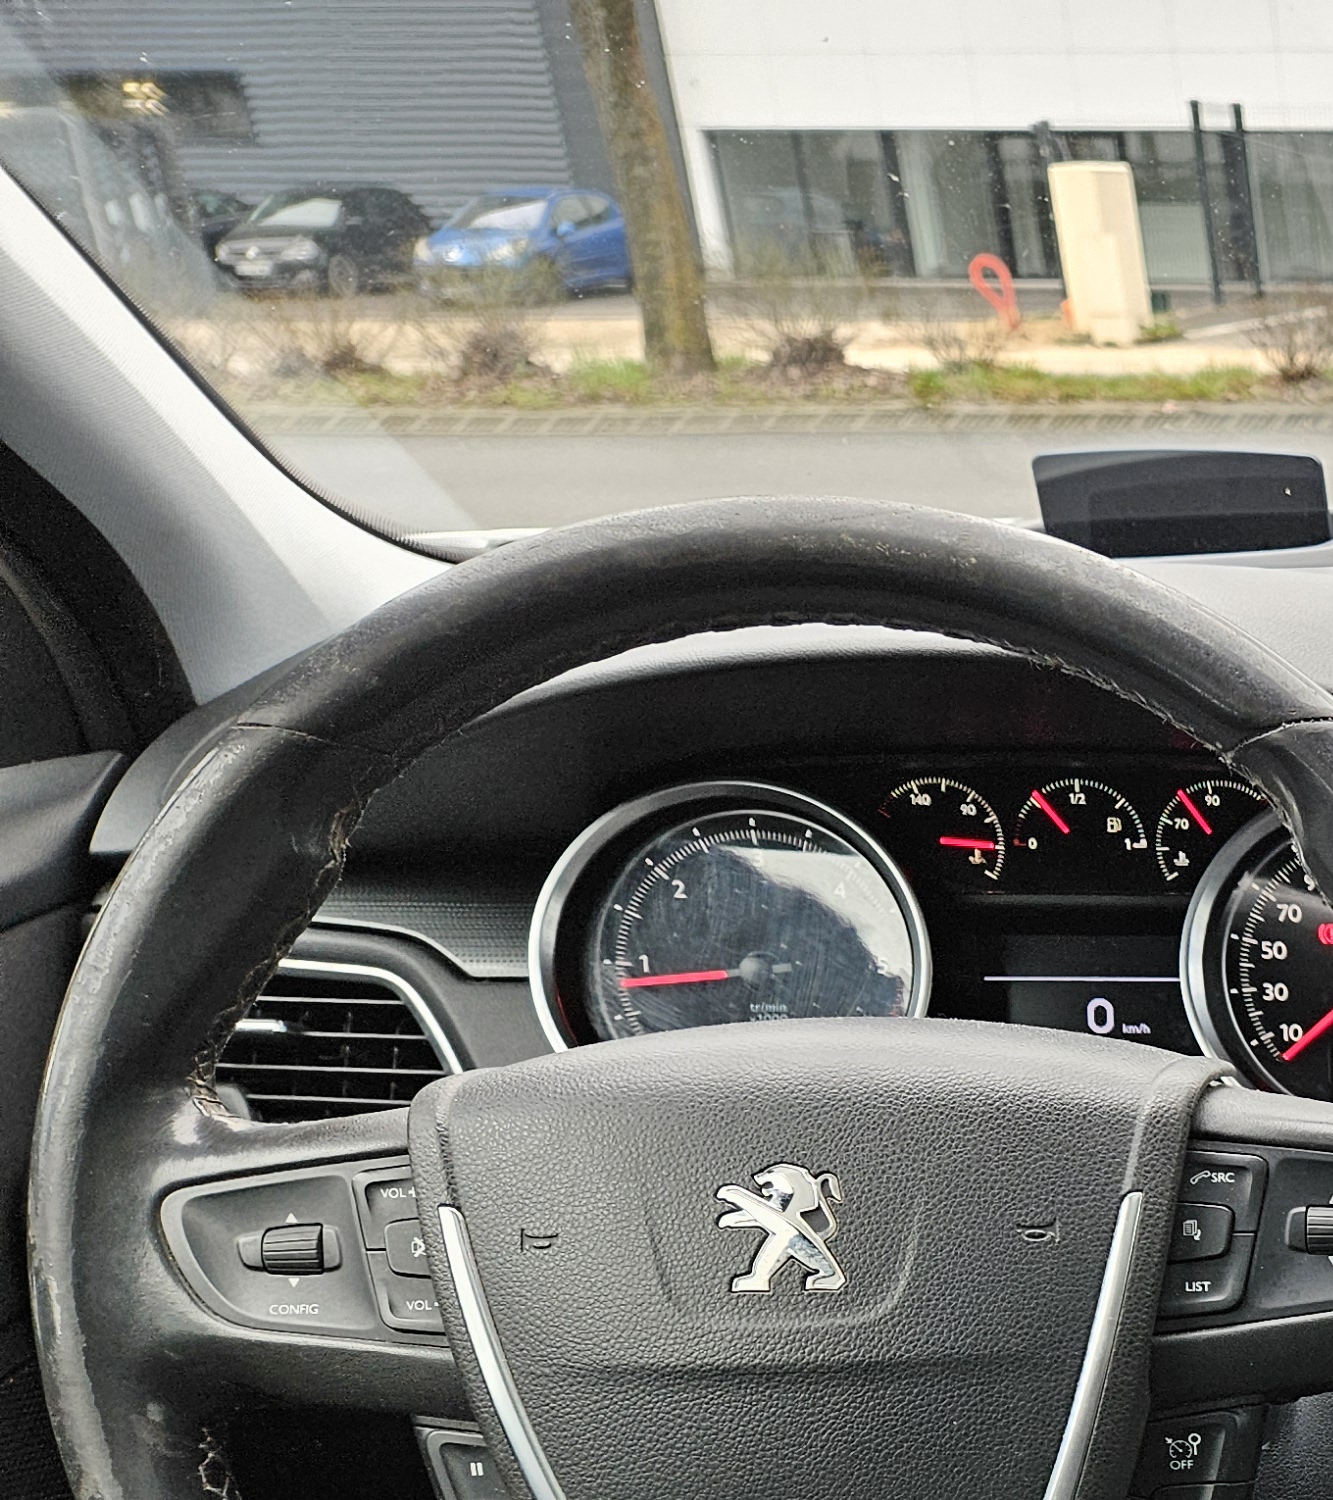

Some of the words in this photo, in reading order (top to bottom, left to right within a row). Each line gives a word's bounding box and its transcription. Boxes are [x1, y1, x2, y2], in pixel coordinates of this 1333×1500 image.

[910, 793, 932, 806] 140
[1069, 793, 1087, 805] 1/2
[1204, 794, 1221, 807] 90
[960, 803, 977, 816] 90
[1174, 818, 1190, 830] 70
[1028, 838, 1038, 850] 0
[1124, 839, 1133, 850] 1
[671, 880, 688, 899] 2
[834, 881, 846, 898] 4
[1303, 874, 1316, 892] 9
[1276, 904, 1302, 923] 70
[1261, 941, 1288, 960] 50
[638, 954, 650, 973] 1
[1262, 983, 1289, 1001] 30
[750, 1001, 789, 1013] tr/min
[1086, 997, 1115, 1034] 0
[1122, 1023, 1152, 1034] km/h
[1279, 1023, 1303, 1042] 10
[1211, 1172, 1235, 1183] SRC
[1184, 1281, 1211, 1292] LIST
[269, 1304, 320, 1315] CONFIG
[1169, 1460, 1194, 1471] OFF
